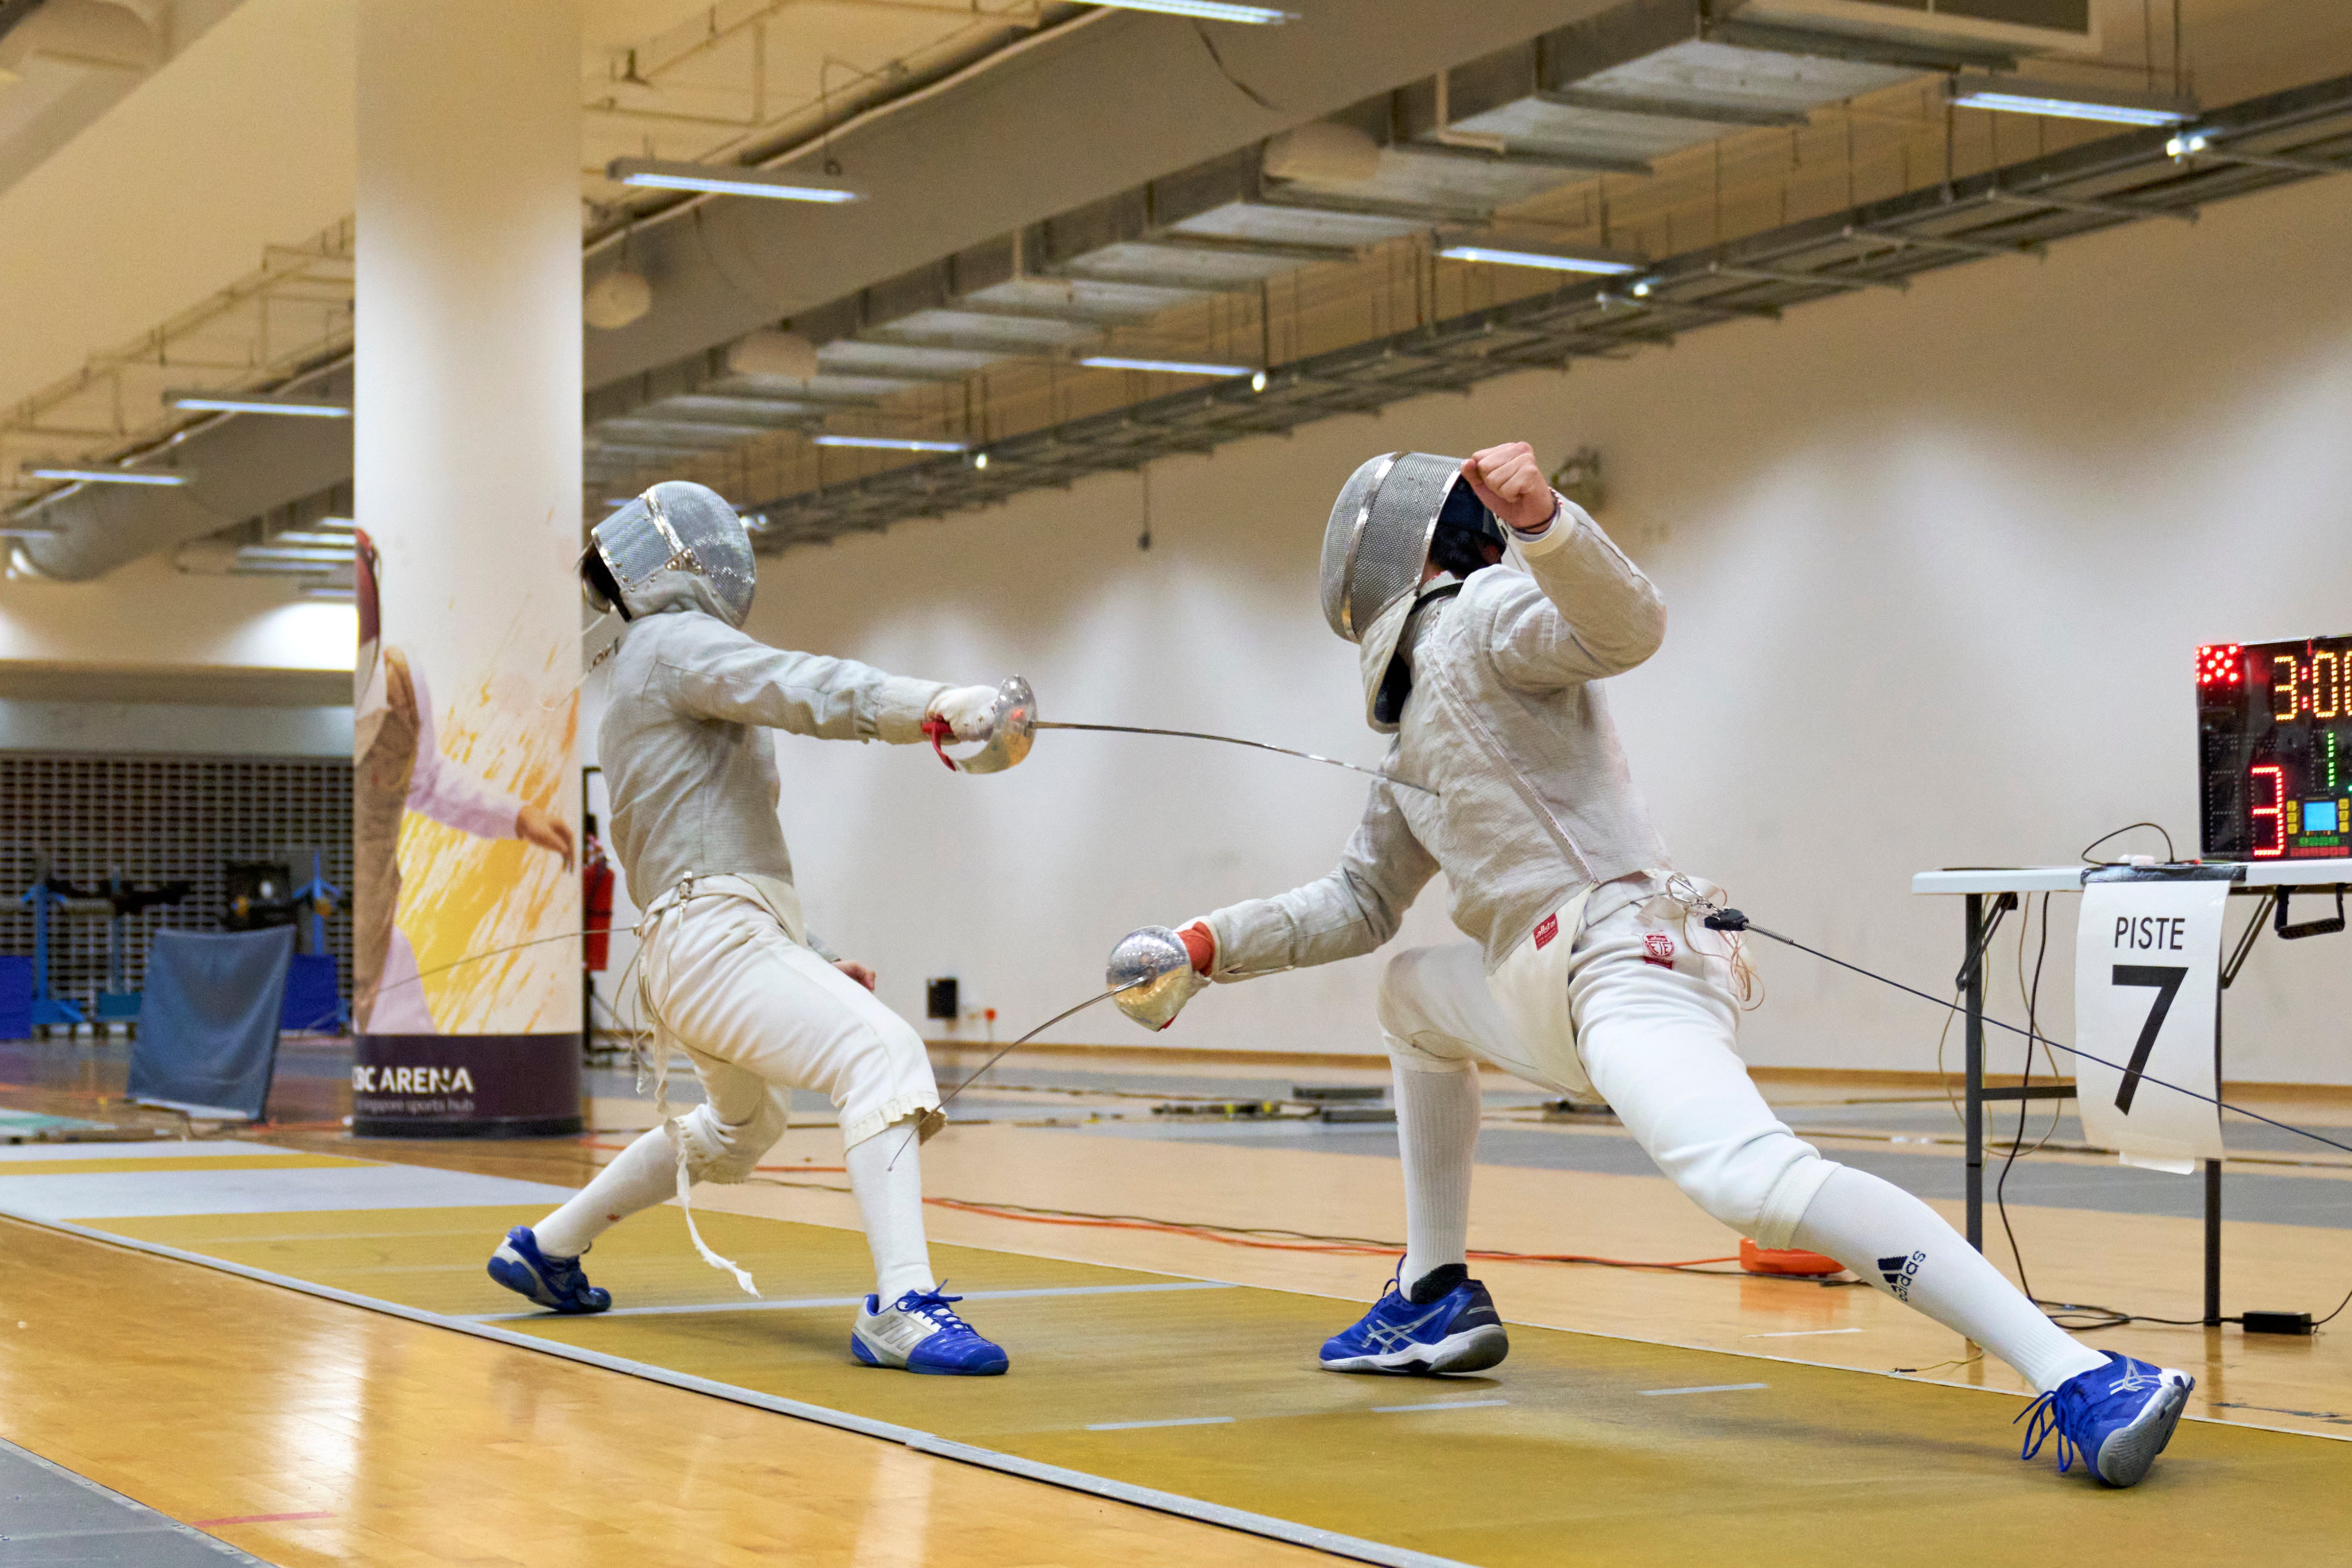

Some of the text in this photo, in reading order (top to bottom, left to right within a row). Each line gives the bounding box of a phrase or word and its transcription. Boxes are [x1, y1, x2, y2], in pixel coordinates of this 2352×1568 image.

[2251, 766, 2284, 857] 3
[2114, 917, 2185, 950] PISTE
[2111, 964, 2189, 1116] 7
[379, 1066, 475, 1093] ARENA
[1895, 1251, 1926, 1302] adidas
